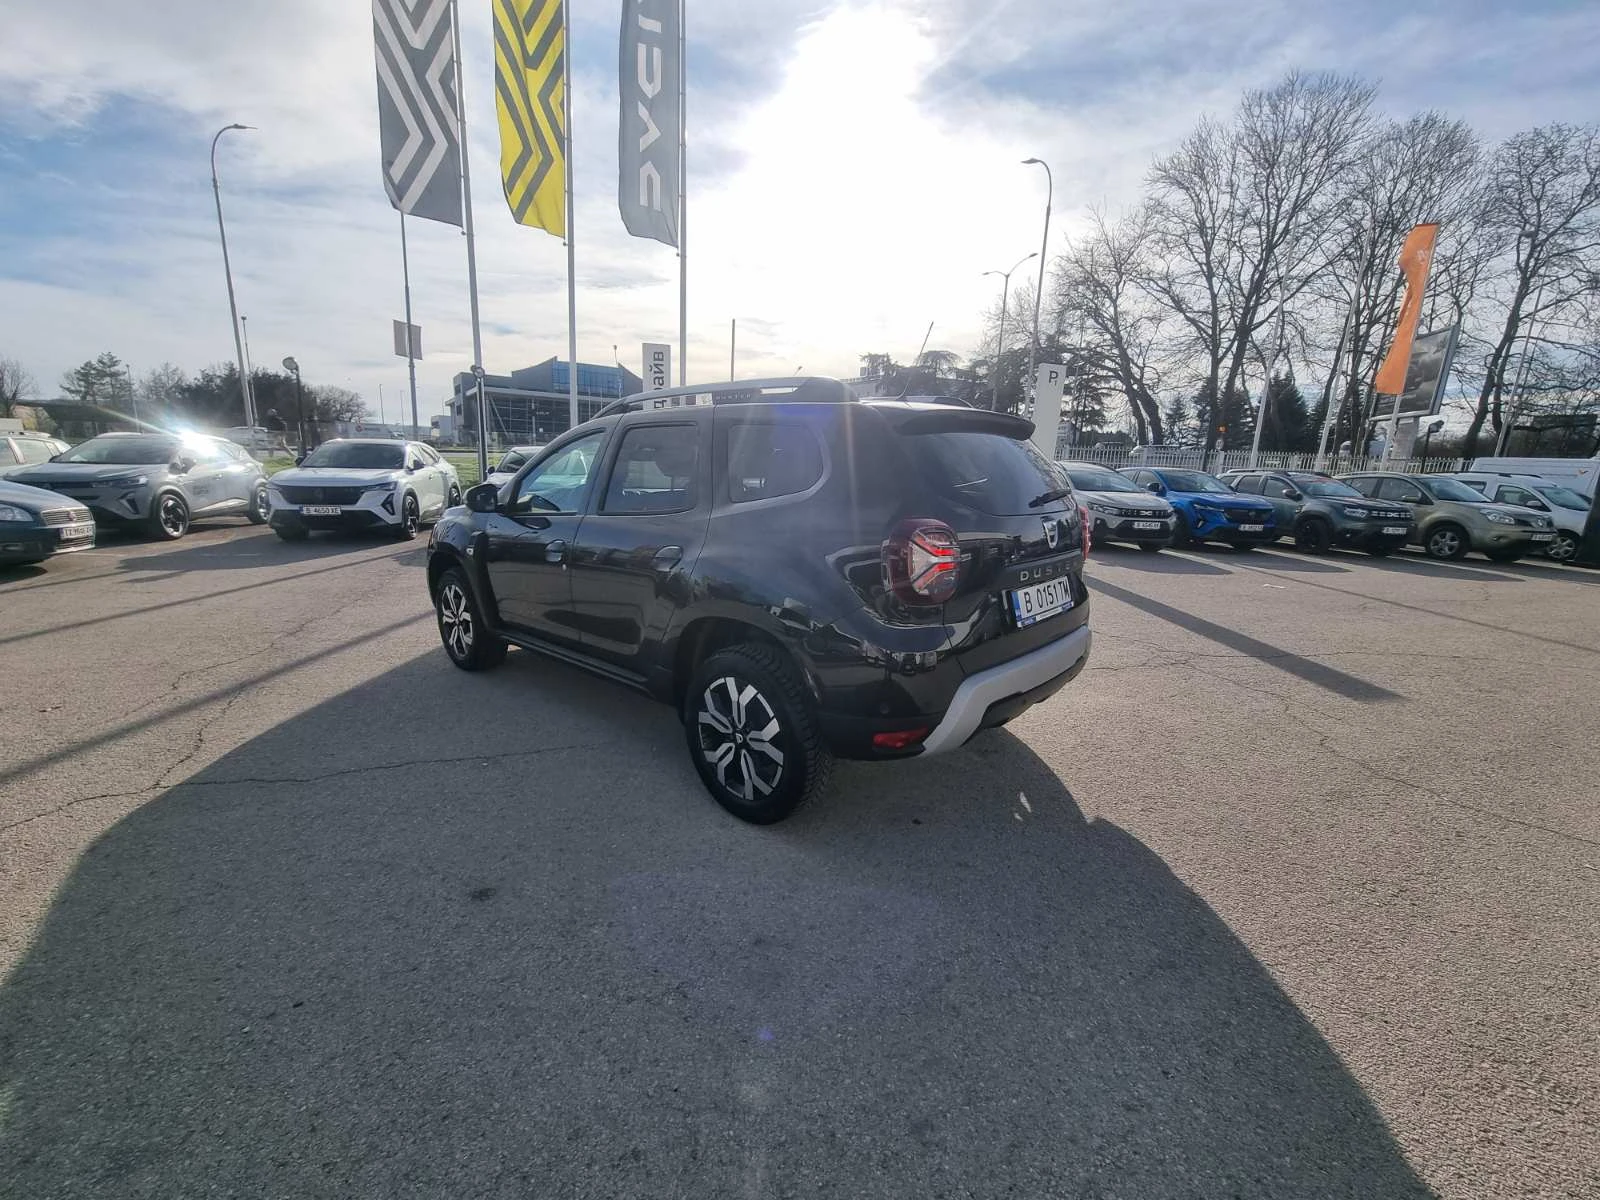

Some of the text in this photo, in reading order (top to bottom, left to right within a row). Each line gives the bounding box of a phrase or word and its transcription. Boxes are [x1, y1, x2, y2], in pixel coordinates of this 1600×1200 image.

[649, 352, 667, 409] дайв
[1024, 591, 1033, 614] B
[1036, 584, 1058, 608] 0151
